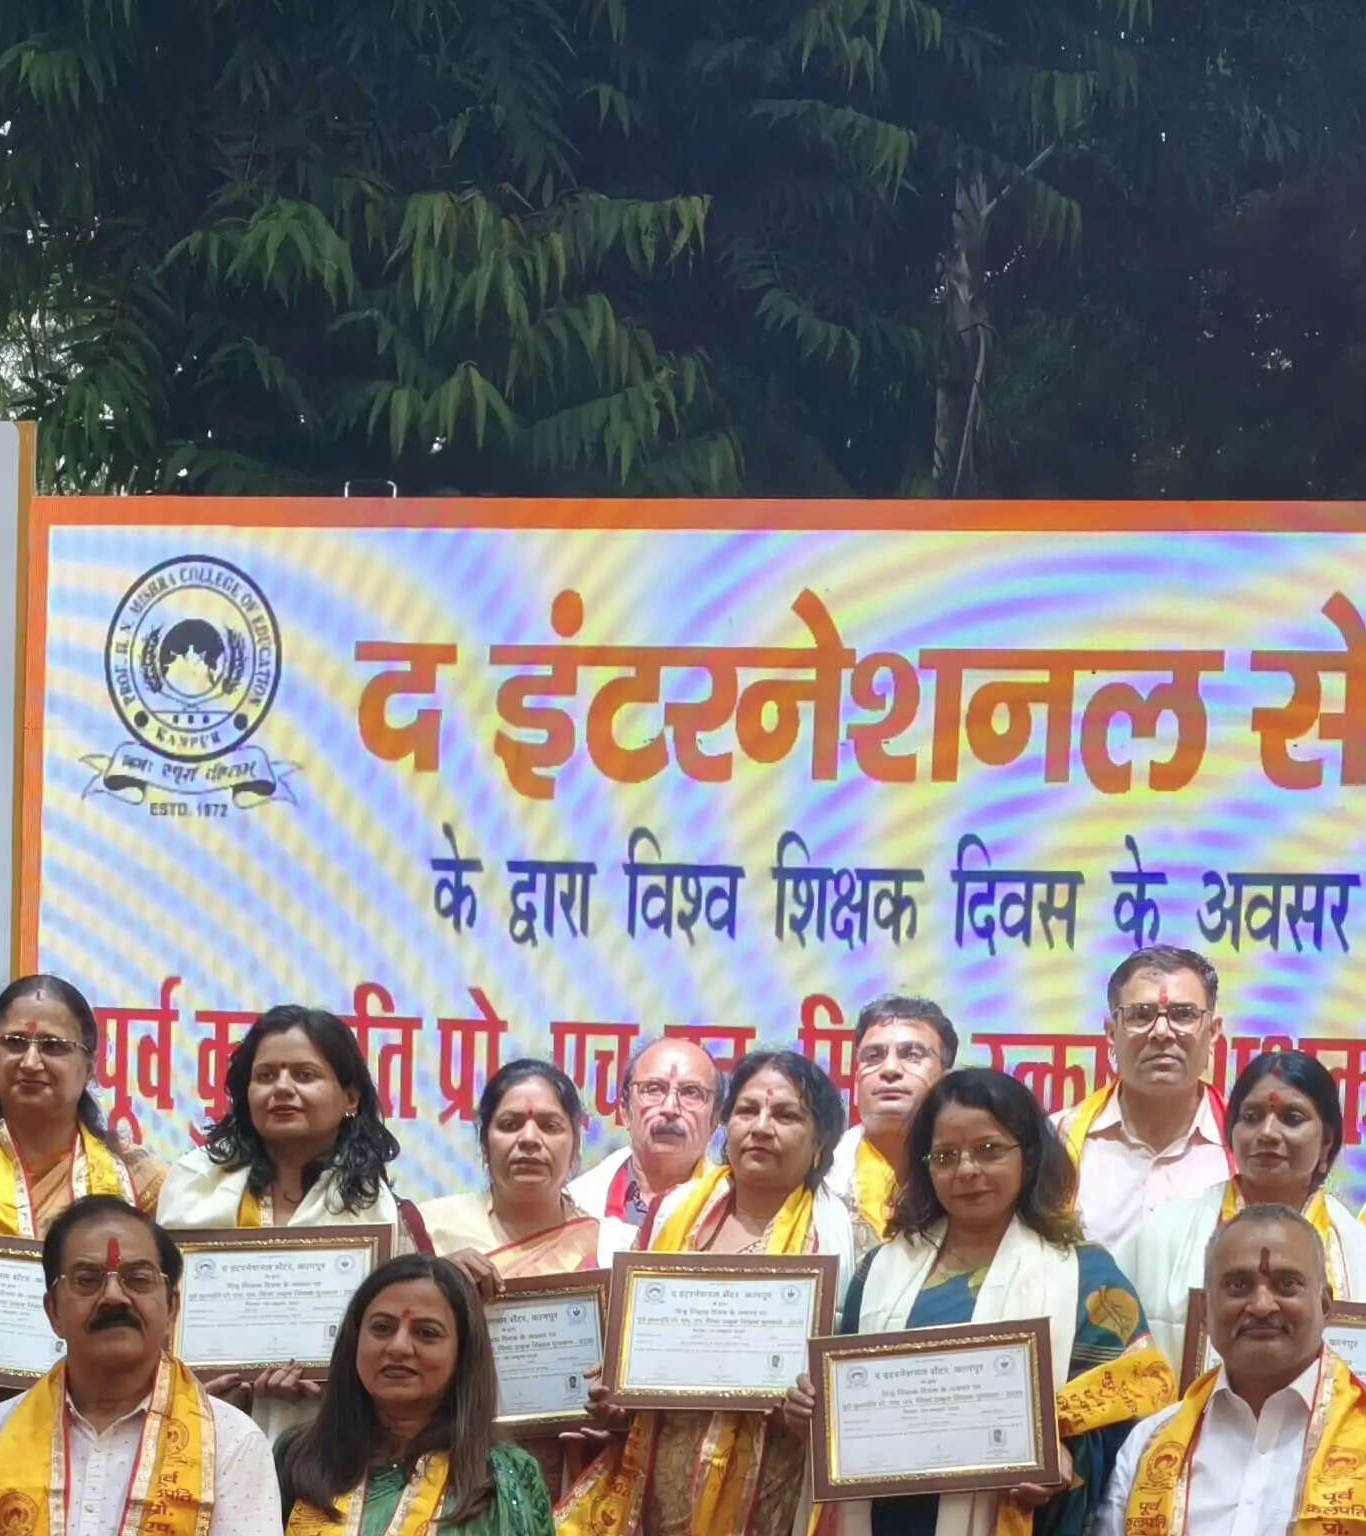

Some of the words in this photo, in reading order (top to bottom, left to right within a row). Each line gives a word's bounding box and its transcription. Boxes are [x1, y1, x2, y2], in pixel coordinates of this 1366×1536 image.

[180, 567, 242, 597] COLLEGE
[252, 615, 272, 708] EDUCATION
[356, 641, 457, 773] द
[490, 588, 1228, 800] इंटरनेशनल
[156, 727, 221, 748] KANPUR
[432, 824, 484, 929] के
[507, 861, 597, 947] द्वारा
[624, 828, 745, 946] विश्व
[773, 832, 924, 956] शिक्षक
[951, 834, 1083, 955] दिवस
[1112, 835, 1168, 949] के
[1197, 873, 1360, 952] अवसर
[1323, 1488, 1354, 1506] पूर्व
